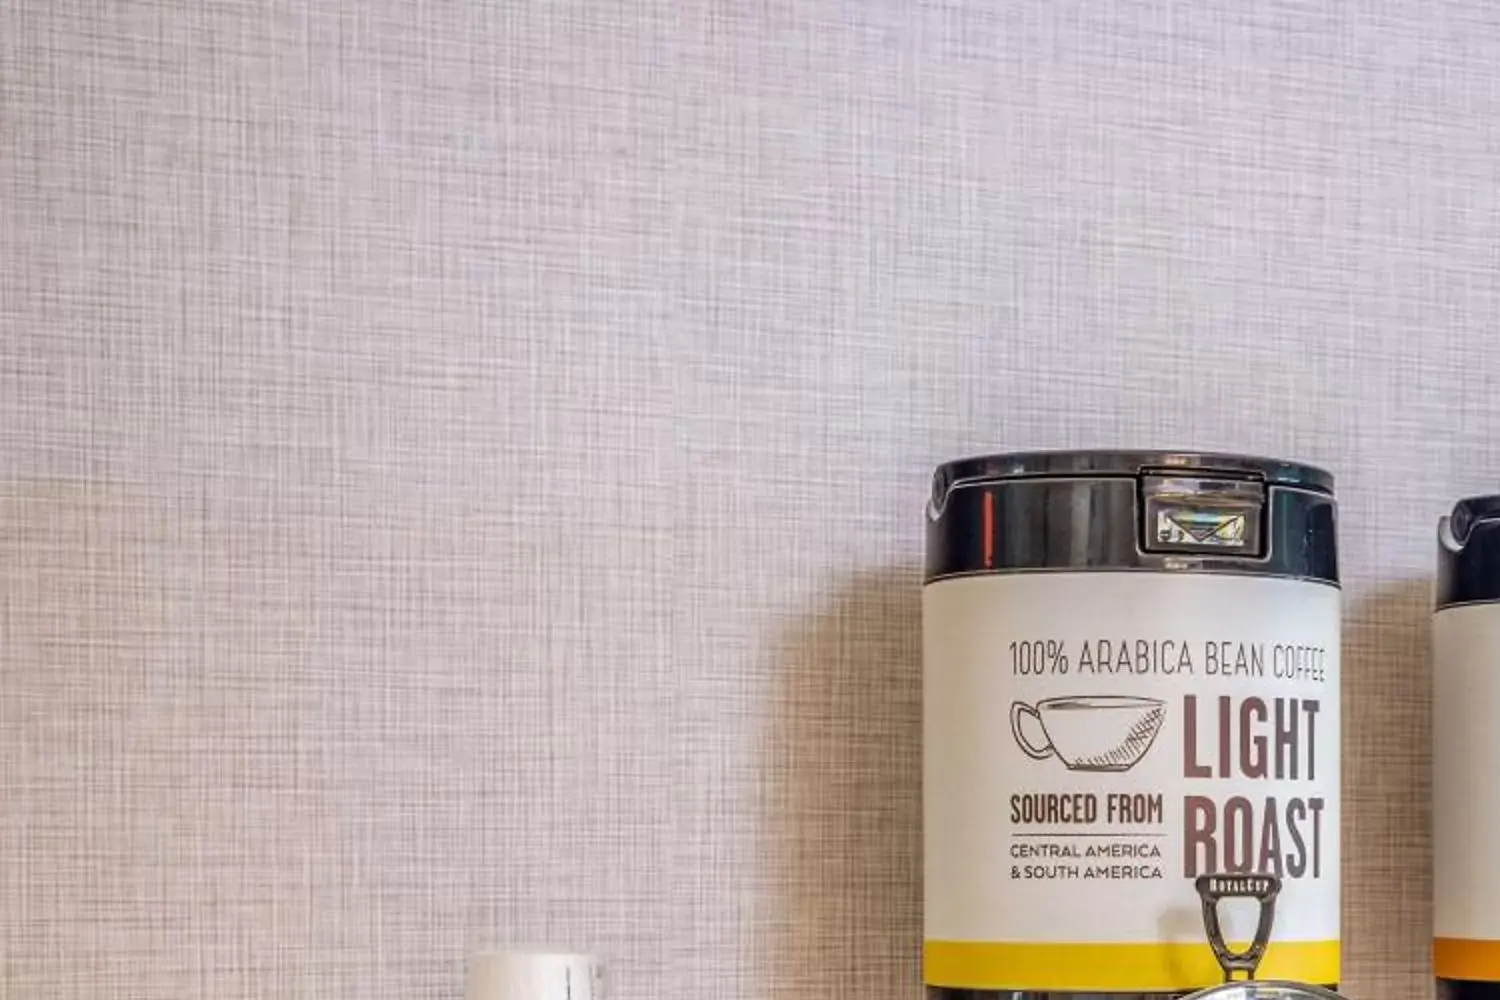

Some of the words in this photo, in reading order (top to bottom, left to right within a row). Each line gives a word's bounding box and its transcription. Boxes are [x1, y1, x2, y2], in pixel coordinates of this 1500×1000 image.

[1009, 640, 1069, 676] 100%
[1078, 640, 1194, 676] ARABICA
[1205, 641, 1264, 677] BEAN
[1273, 644, 1325, 682] COFFEE
[1183, 694, 1320, 780] LIGHT
[1010, 793, 1097, 825] SOURCED
[1107, 793, 1163, 824] FROM
[1010, 844, 1081, 858] CENTRAL
[1085, 844, 1161, 858] AMERICA
[1183, 795, 1324, 879] ROAST
[1010, 866, 1021, 879] &
[1024, 865, 1079, 879] SOUTH
[1084, 865, 1163, 879] AMERICA
